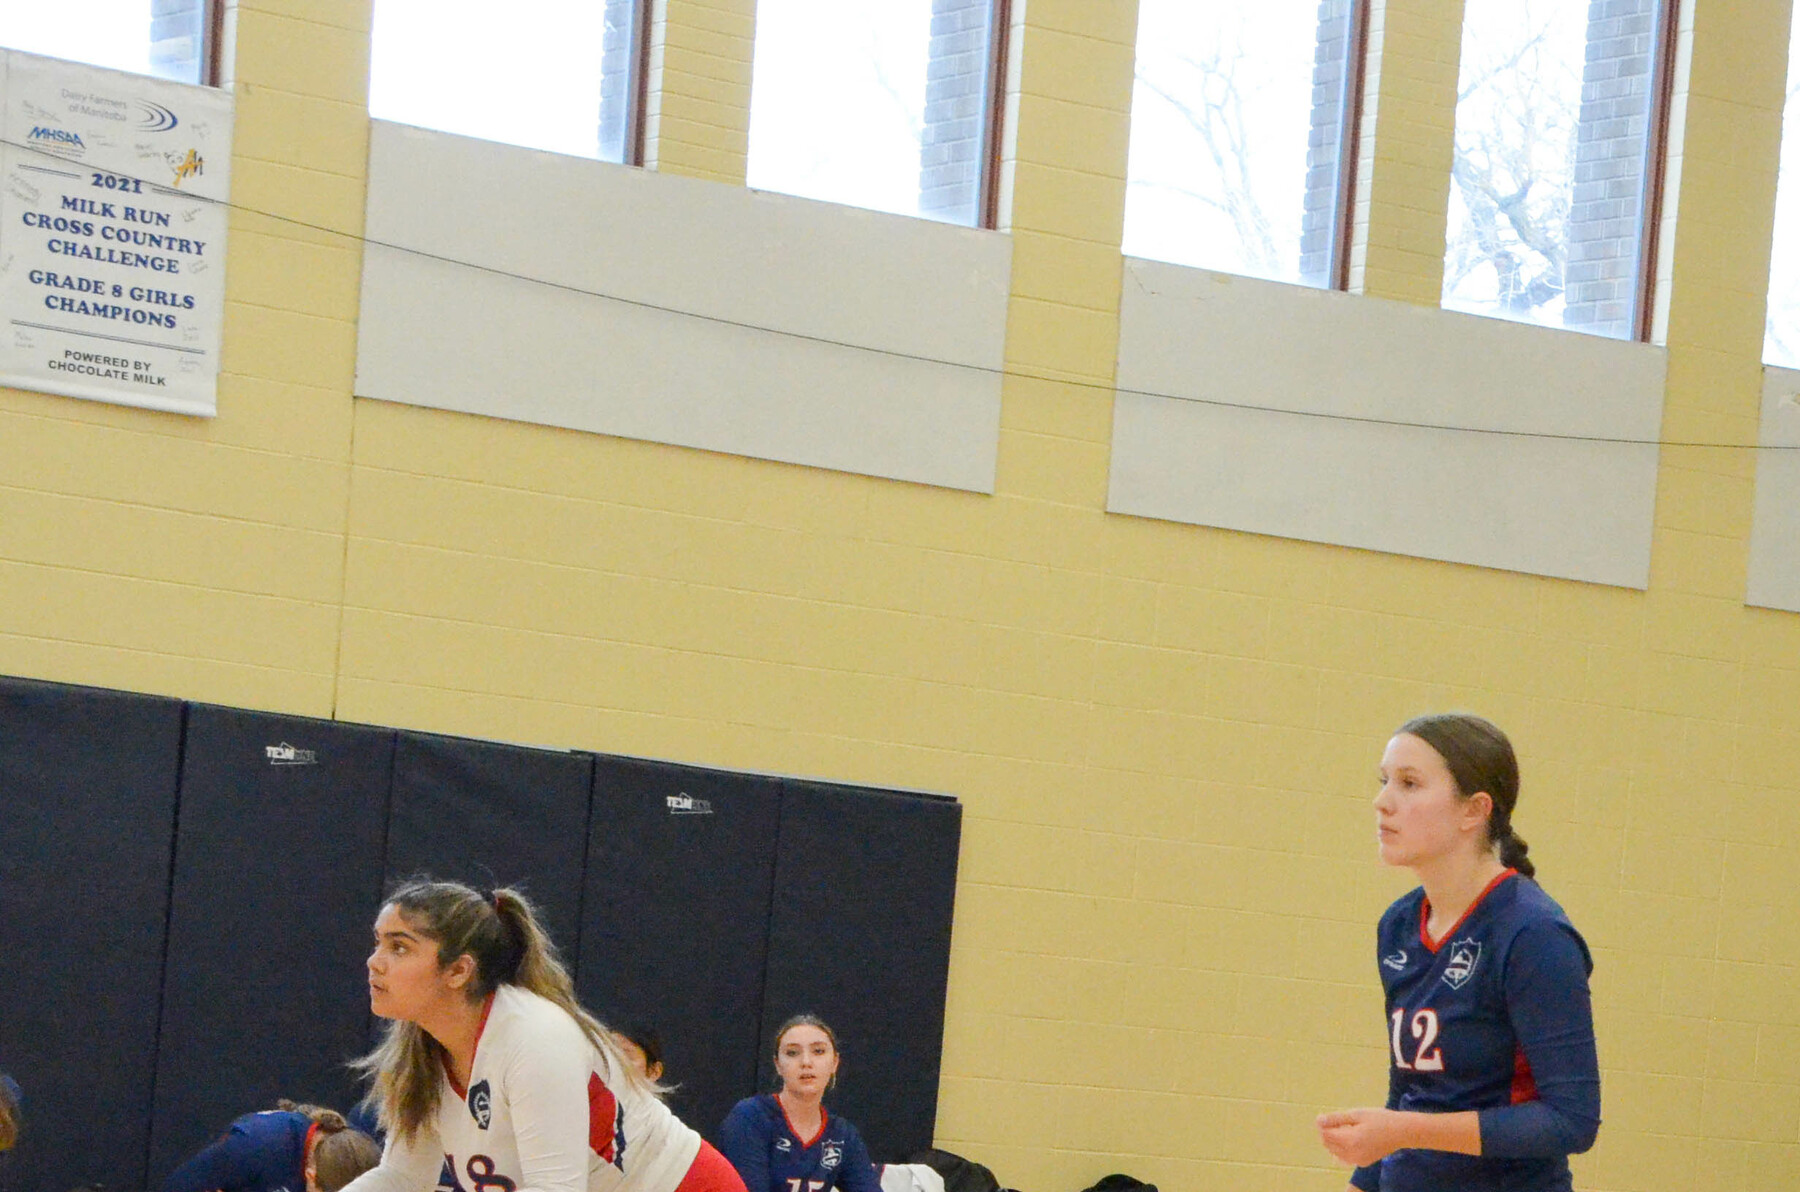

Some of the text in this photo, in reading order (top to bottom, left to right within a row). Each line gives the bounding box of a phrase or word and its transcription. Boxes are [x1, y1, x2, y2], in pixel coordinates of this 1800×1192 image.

[28, 126, 86, 149] MHSAA
[91, 173, 144, 194] 2021
[61, 195, 116, 219] MILK
[124, 206, 171, 228] RUN
[22, 211, 206, 256] CROSS COUNTRY
[48, 238, 180, 274] CHALLENGE
[29, 269, 195, 310] GRADE 8 GIRLS
[44, 294, 177, 329] CHAMPIONS
[48, 360, 166, 386] CHOCOLATE MILK
[64, 350, 152, 371] POWERED BY
[1391, 1007, 1445, 1072] 12
